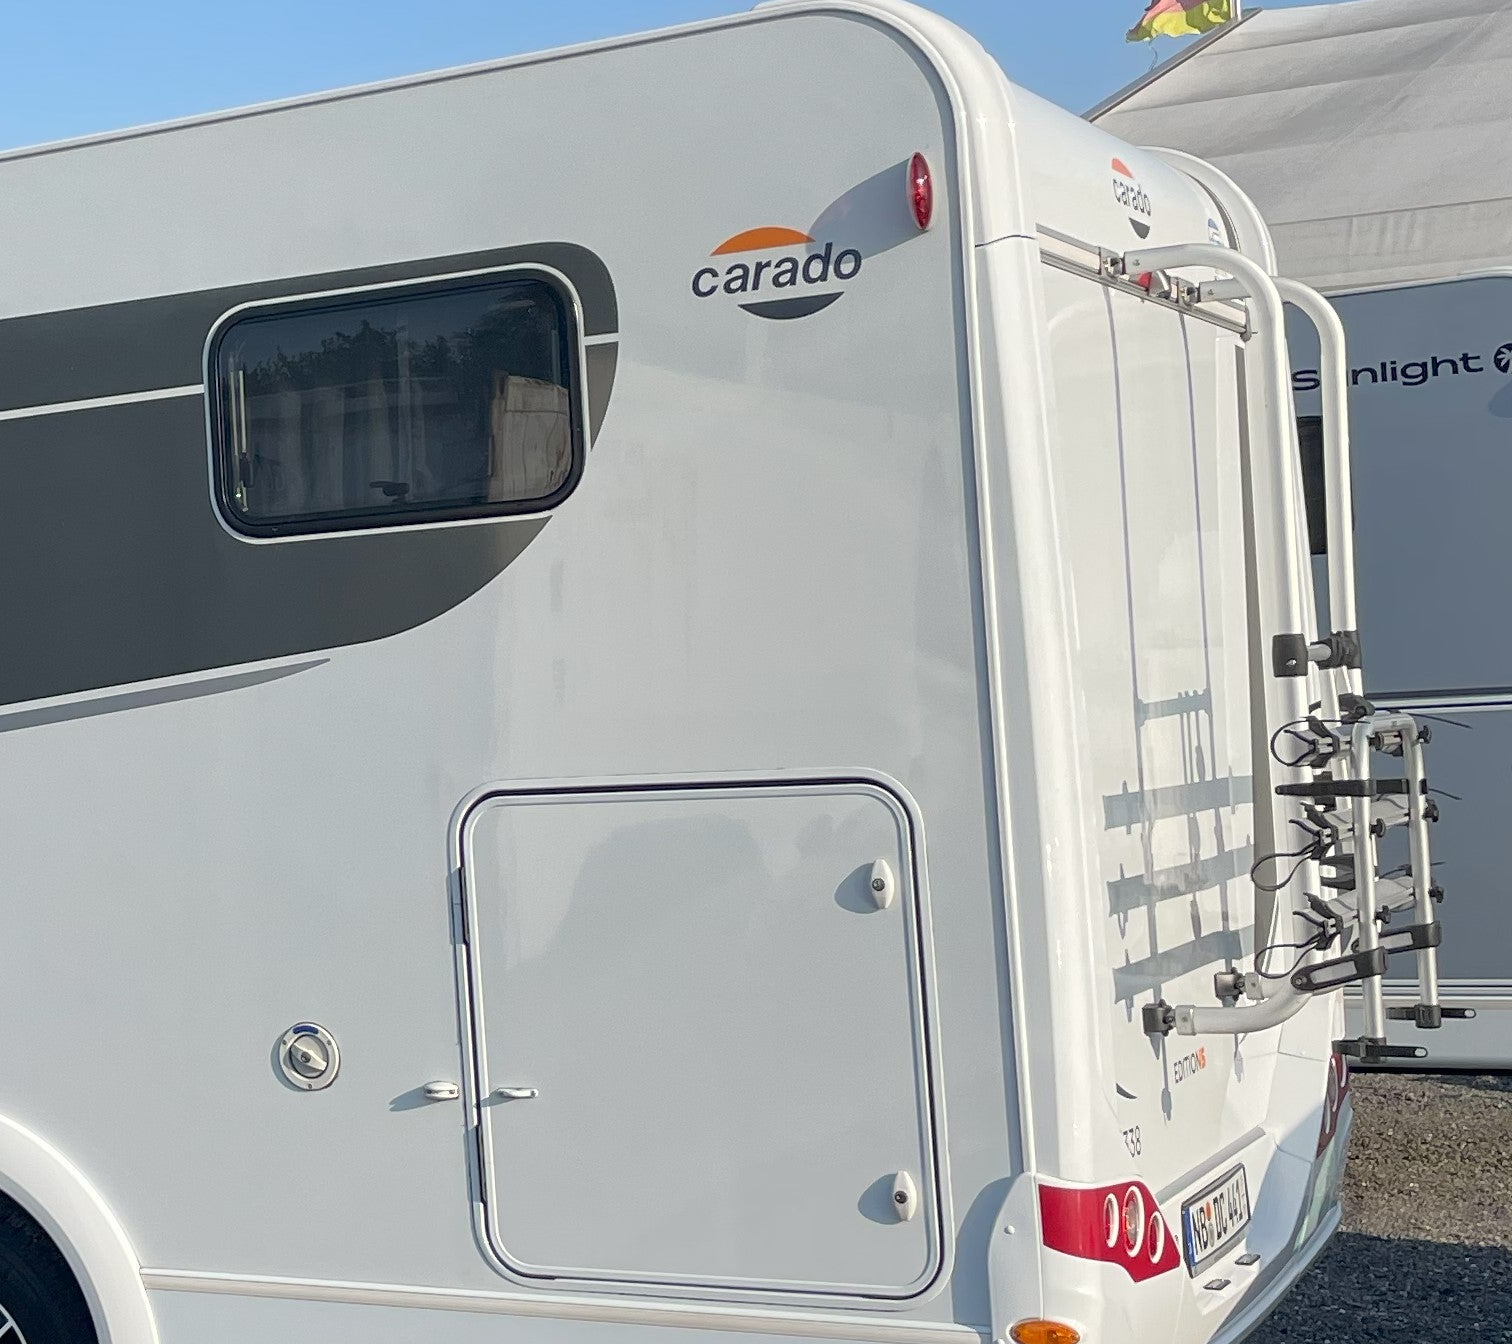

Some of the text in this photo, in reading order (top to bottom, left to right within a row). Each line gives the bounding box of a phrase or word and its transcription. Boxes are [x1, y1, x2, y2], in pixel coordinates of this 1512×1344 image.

[1112, 178, 1151, 217] carado
[691, 241, 863, 298] carado
[1291, 353, 1484, 391] snlight
